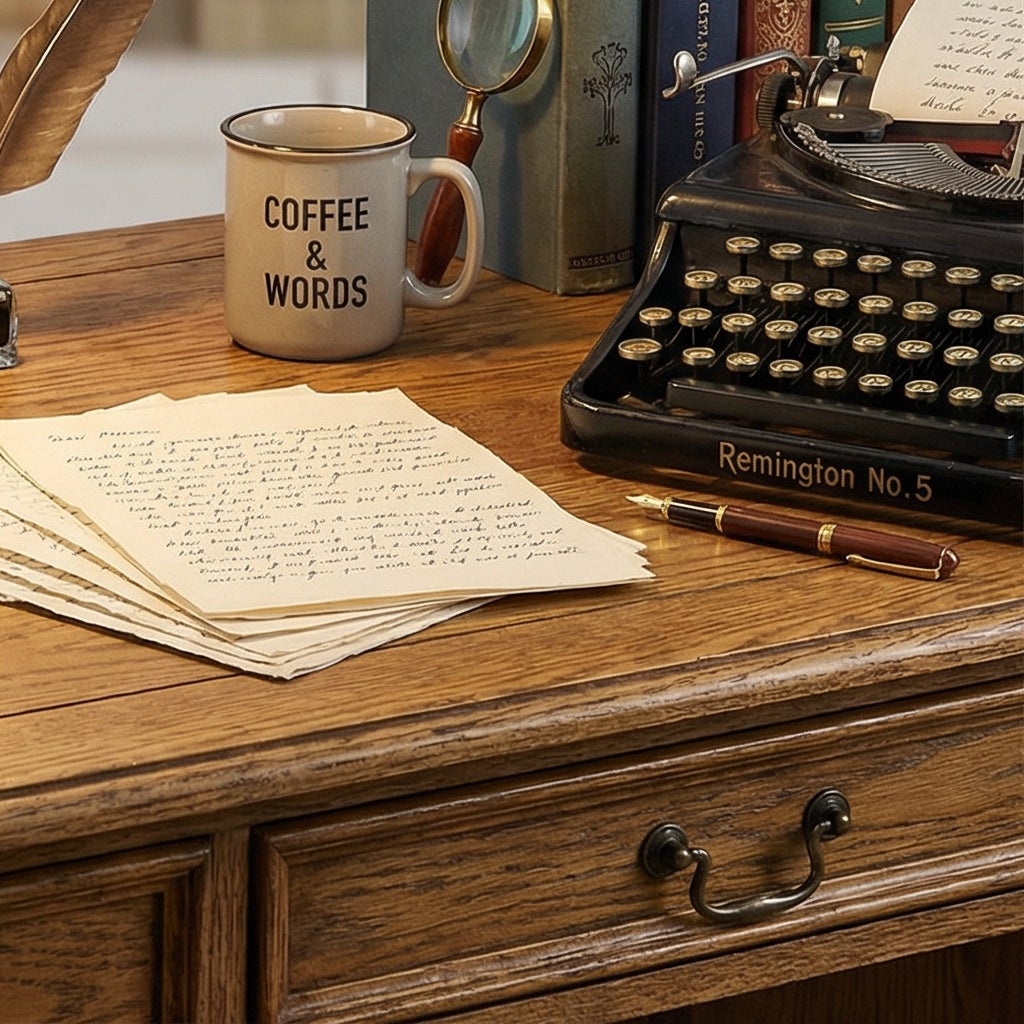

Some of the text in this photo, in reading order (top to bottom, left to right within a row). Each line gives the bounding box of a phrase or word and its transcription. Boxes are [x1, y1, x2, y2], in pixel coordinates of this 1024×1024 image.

[264, 195, 369, 232] COFFEE
[306, 240, 327, 271] &
[264, 272, 368, 309] WORDS
[719, 441, 854, 489] Remington
